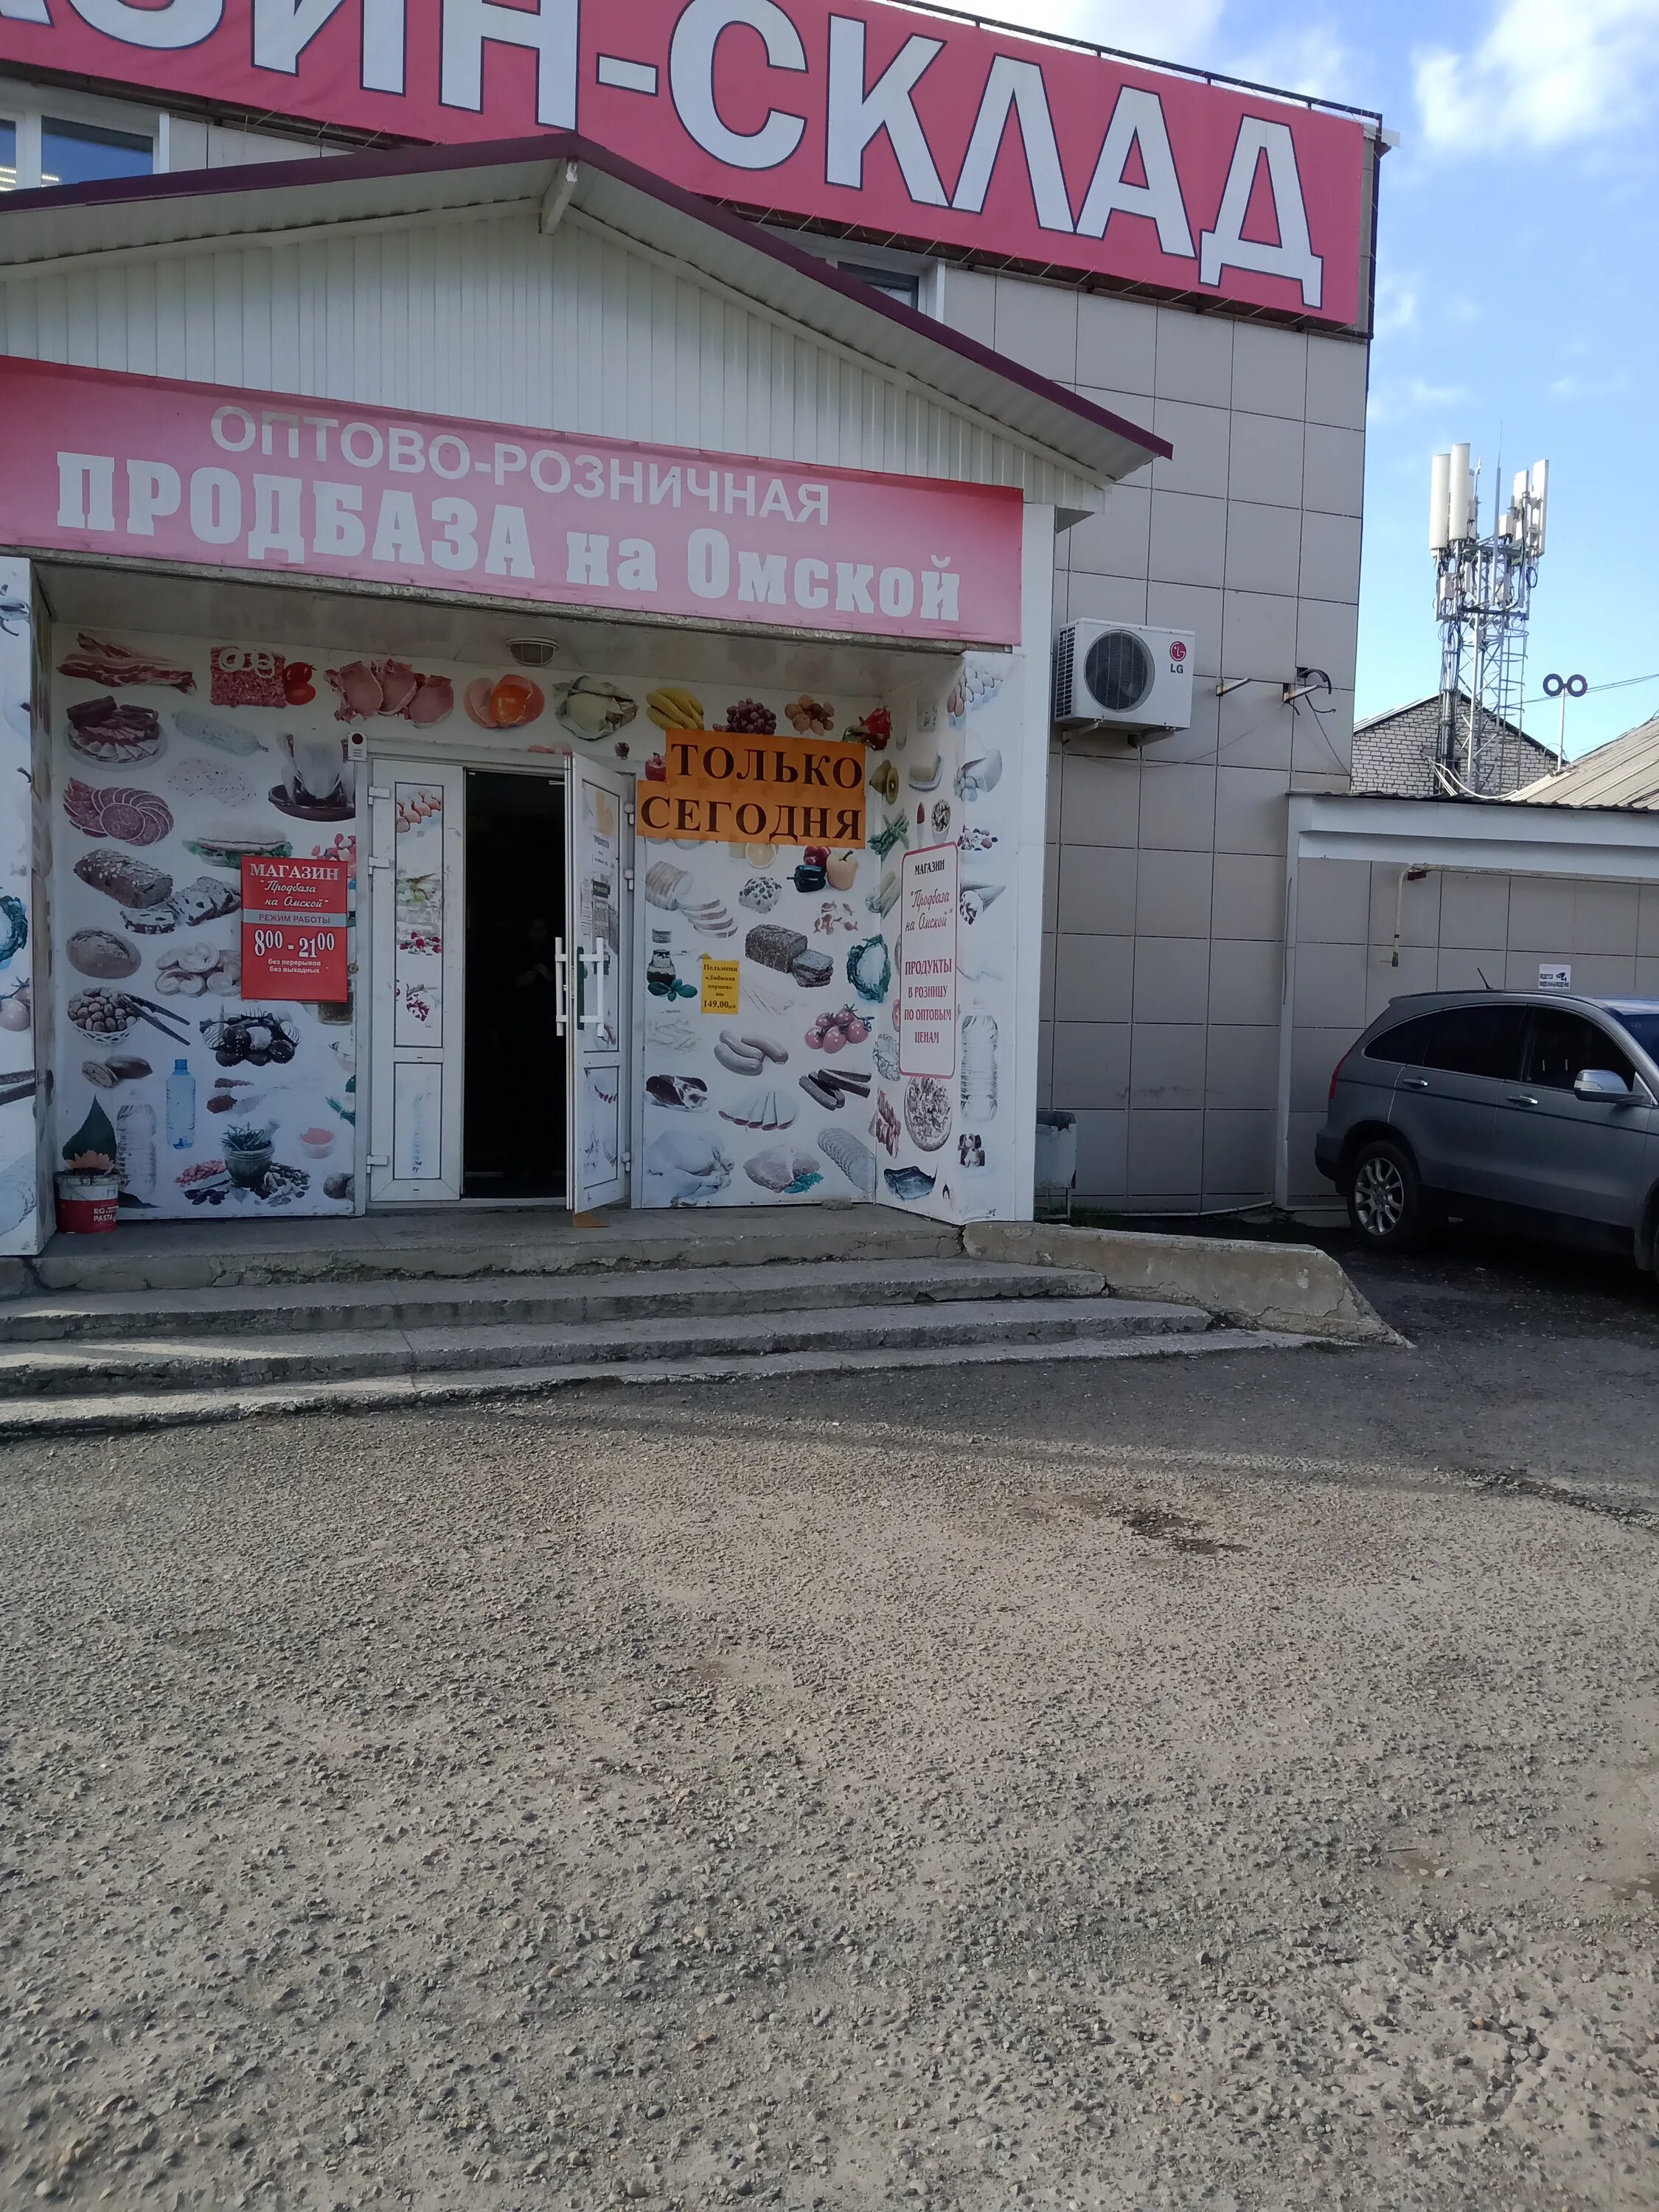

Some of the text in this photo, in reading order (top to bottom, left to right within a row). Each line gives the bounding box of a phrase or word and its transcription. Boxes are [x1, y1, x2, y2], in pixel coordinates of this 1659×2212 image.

[0, 0, 1324, 309] Н-СКЛАД
[211, 406, 829, 526] ОПТОВО-РОЗНИЧНАЯ
[56, 451, 960, 622] ПРОДБАЗА на Омской
[1169, 663, 1184, 674] LG
[670, 743, 863, 789] ТОЛЬКО
[641, 796, 863, 844] СЕГОДНЯ
[249, 863, 339, 880] МАГАЗИН
[914, 859, 945, 876] МАГАЗИН
[264, 897, 279, 906] на
[259, 914, 331, 924] РЕЖИМ РАБОТЫ
[905, 919, 915, 931] на
[282, 959, 321, 967] перерывов
[703, 964, 738, 972] Пельмени
[905, 959, 953, 975] ПРОДУКТЫ
[908, 985, 948, 998] В РОЗНИЦУ
[904, 1008, 952, 1020] ПО ОПТОВЫМ
[914, 1031, 939, 1044] ЦЕНАМ
